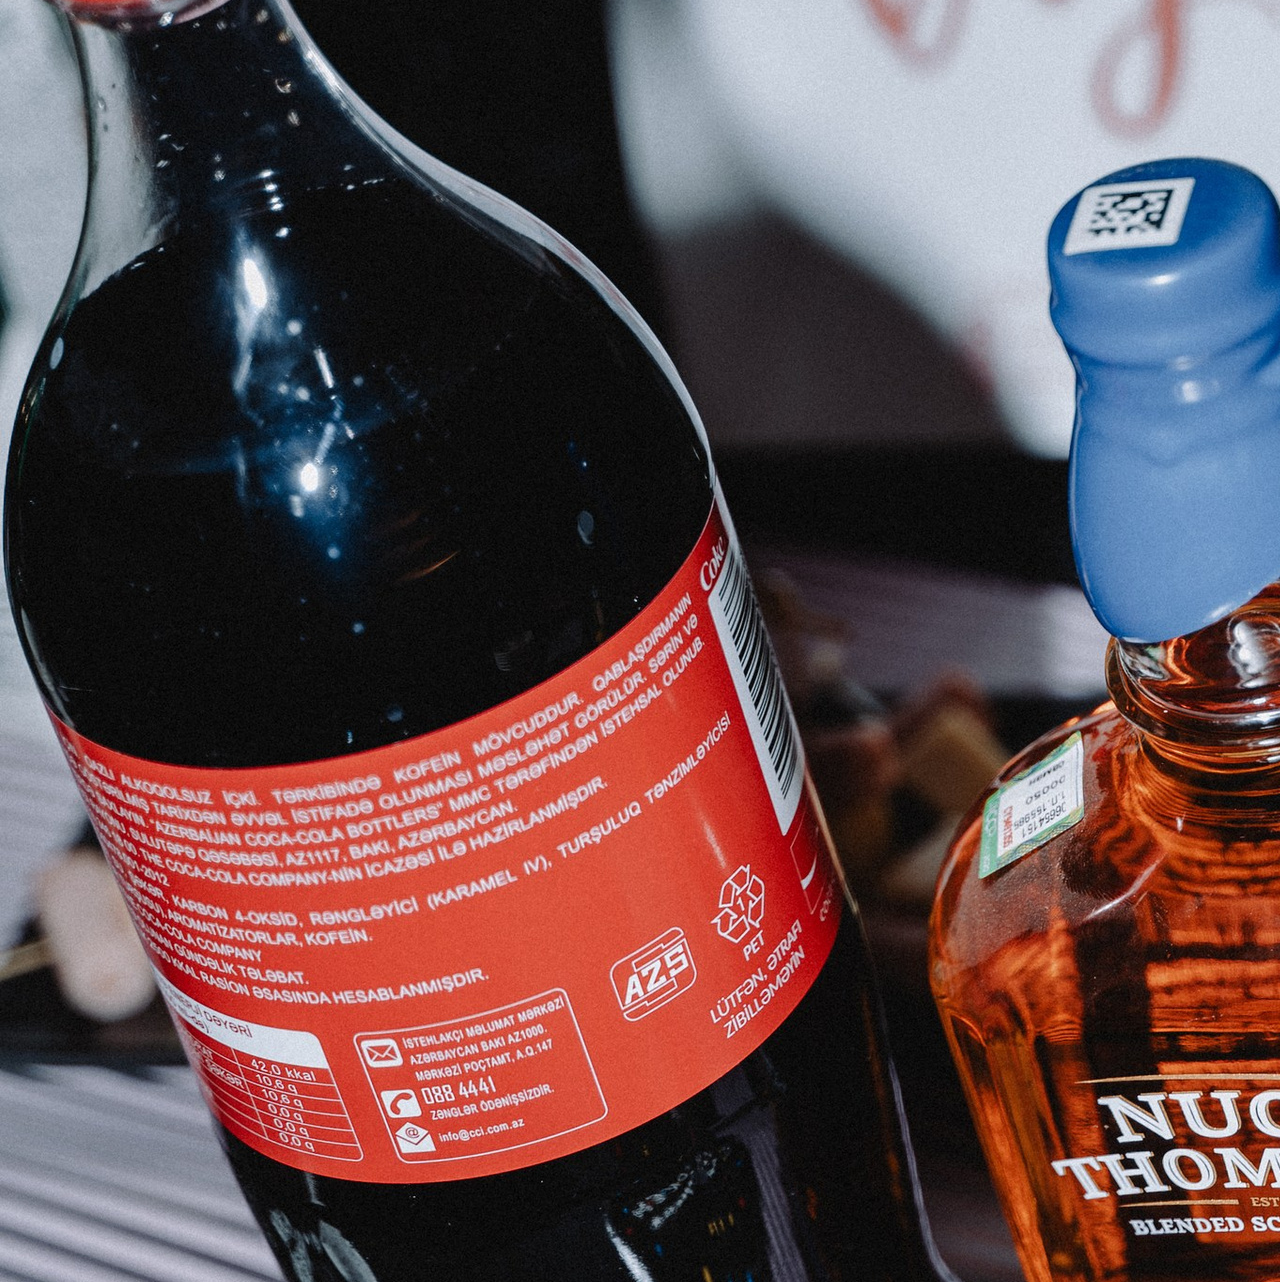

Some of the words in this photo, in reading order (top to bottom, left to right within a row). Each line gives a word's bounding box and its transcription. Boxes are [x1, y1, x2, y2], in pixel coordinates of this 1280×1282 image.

[700, 537, 726, 591] Coke
[120, 773, 213, 805] ALKOQOLSUZ
[272, 773, 382, 805] TƏRKİBİNDƏ
[393, 750, 462, 784] KOFEİN
[472, 691, 584, 757] MÖVCUDDUR.
[591, 592, 693, 692] QABLAŞDIRMANIN
[230, 810, 288, 827] ƏVVƏL
[291, 798, 374, 825] İSTİFADƏ
[378, 769, 474, 810] OLUNMASI
[477, 722, 570, 779] MƏSLƏHƏT
[574, 670, 647, 730] GÖRÜLÜR.
[648, 634, 684, 675] SƏRİN
[682, 613, 698, 635] VƏ
[244, 826, 345, 848] COCA-COLA
[448, 784, 492, 813] MMC
[493, 730, 599, 794] TƏRƏFİNDƏN
[600, 683, 663, 739] İSTEHSAL
[662, 636, 706, 687] OLUNUB.
[171, 893, 228, 921] KARBON
[308, 896, 419, 926] RƏNGLƏYİCİ
[426, 869, 518, 910] (KARAMEL
[523, 854, 553, 876] IV),
[556, 801, 643, 858] TURŞULUQ
[643, 711, 732, 805] TƏNZİMLƏYİCİSİ
[349, 840, 396, 860] BAKI,
[397, 799, 518, 851] AZƏRBAYCAN.
[165, 858, 248, 885] COCA-COLA
[366, 851, 436, 879] İCAZƏSİ
[438, 839, 468, 862] İLƏ
[196, 938, 263, 963] COMPANY
[304, 928, 373, 947] KOFEİN.
[742, 930, 766, 962] PET
[201, 971, 251, 997] RASİON
[252, 988, 333, 1005] ƏSASINDA
[333, 967, 490, 1005] HESABLANMIŞDIR.
[237, 966, 310, 986] TƏLƏBAT.
[709, 967, 768, 1024] LÜTFƏN,
[766, 919, 803, 971] ƏTRAFI
[722, 945, 806, 1038] ZİBİLLƏMƏYİN
[203, 1009, 253, 1038] DƏYƏRİ
[402, 1030, 464, 1050] İSTEHLAKÇI
[465, 1014, 516, 1038] MƏLUMAT
[517, 995, 566, 1023] MƏRKƏZİ
[409, 1046, 480, 1066] AZƏRBAYCAN
[481, 1039, 507, 1055] BAKI
[507, 1024, 548, 1044] AZ1000.
[415, 1063, 463, 1083] MƏRKƏZİ
[464, 1052, 516, 1074] POÇTAMT,
[516, 1039, 554, 1061] A.Q.147
[250, 1059, 282, 1077] 42,0
[285, 1067, 317, 1082] kkal
[255, 1074, 285, 1091] 10,6
[261, 1088, 291, 1105] 10,6
[421, 1084, 456, 1105] 088
[458, 1075, 497, 1099] 4441
[430, 1102, 479, 1121] ZƏNGLƏR
[480, 1082, 555, 1112] ÖDƏNİŞSİZDİR.
[267, 1103, 291, 1119] 0,0
[273, 1117, 297, 1133] 0,0
[279, 1132, 302, 1147] 0,0
[438, 1118, 525, 1143] info@cci.com.az
[1129, 1216, 1245, 1237] BLENDED
